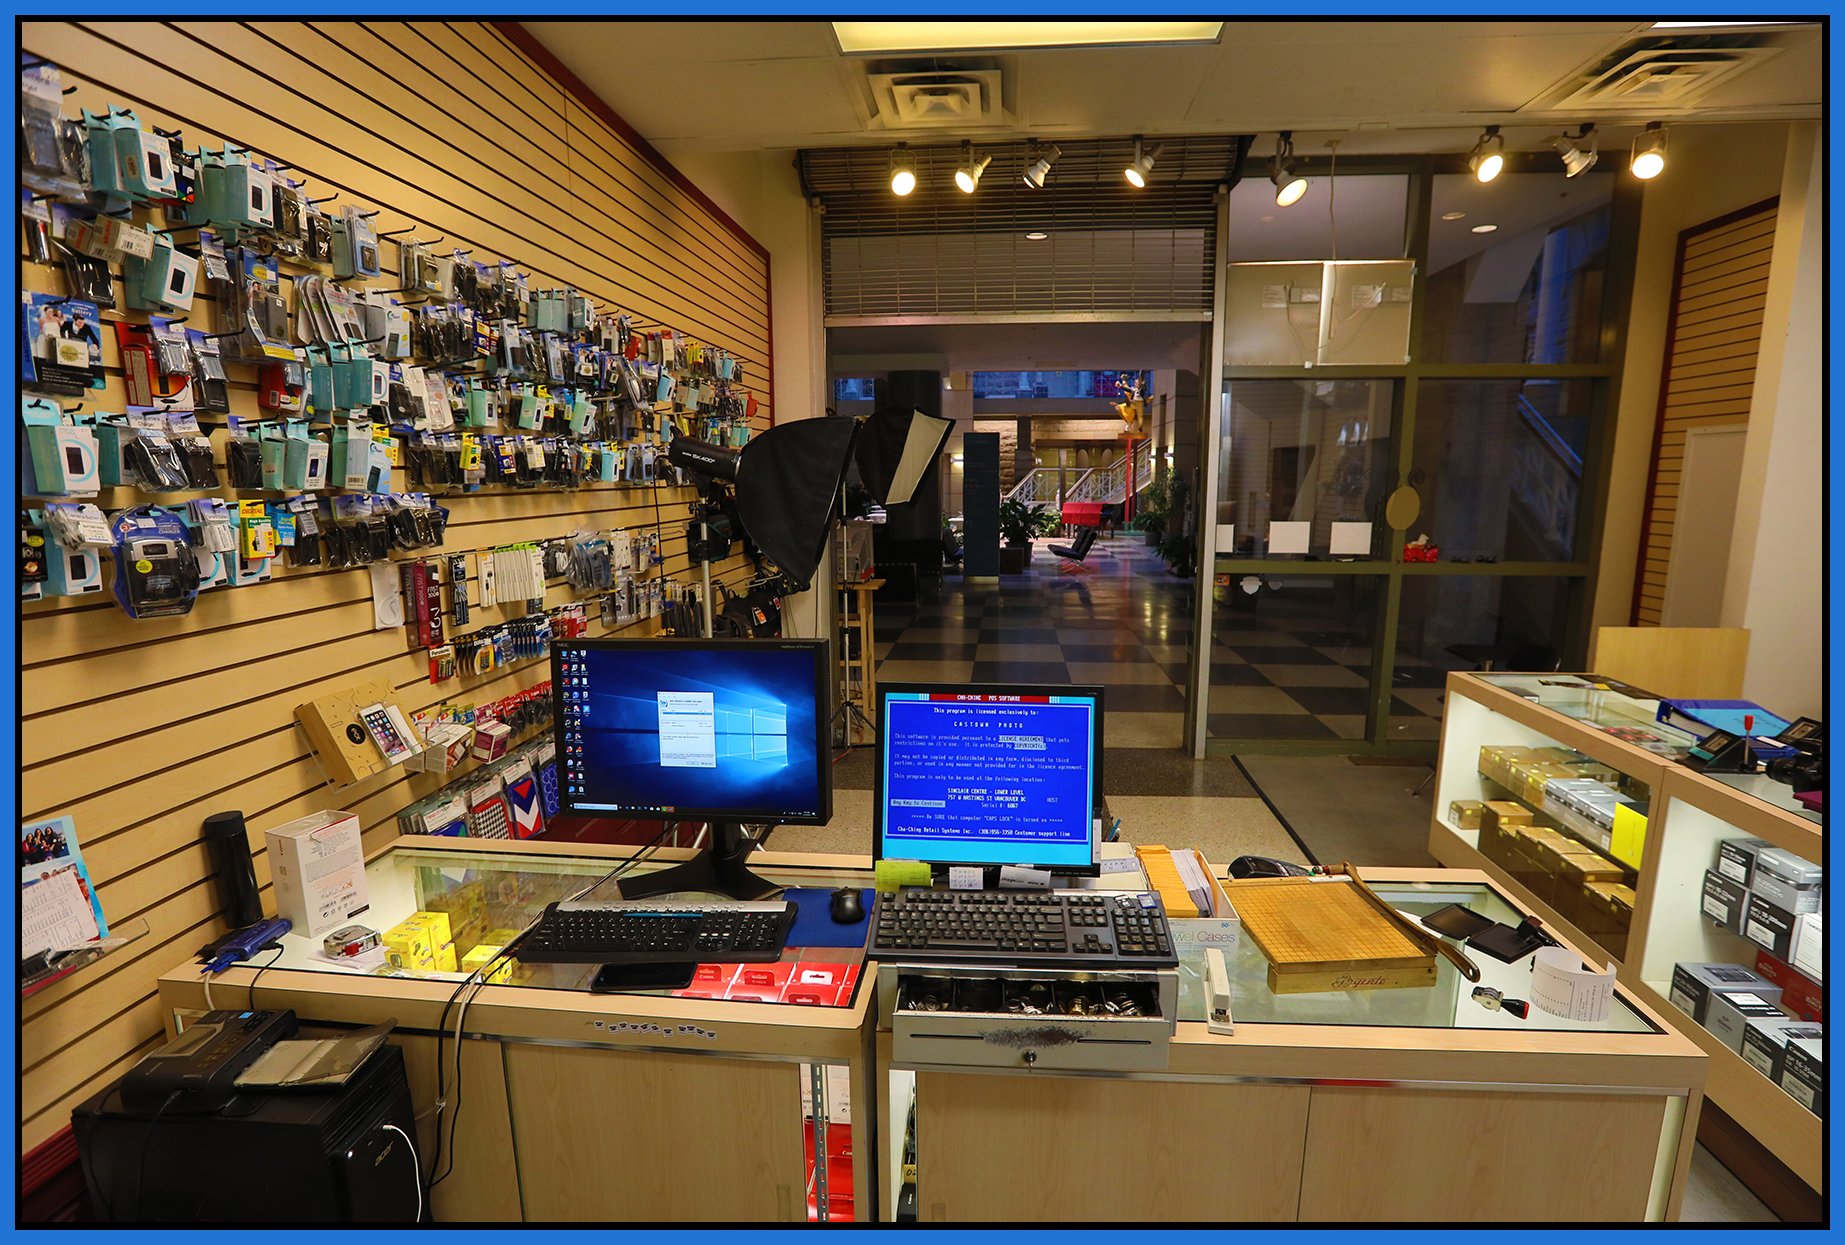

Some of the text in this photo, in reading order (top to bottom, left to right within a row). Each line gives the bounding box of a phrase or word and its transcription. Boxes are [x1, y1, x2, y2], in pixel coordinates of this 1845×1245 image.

[1752, 897, 1770, 909] Canon
[1197, 930, 1236, 943] Cases
[1789, 1045, 1808, 1062] Canon
